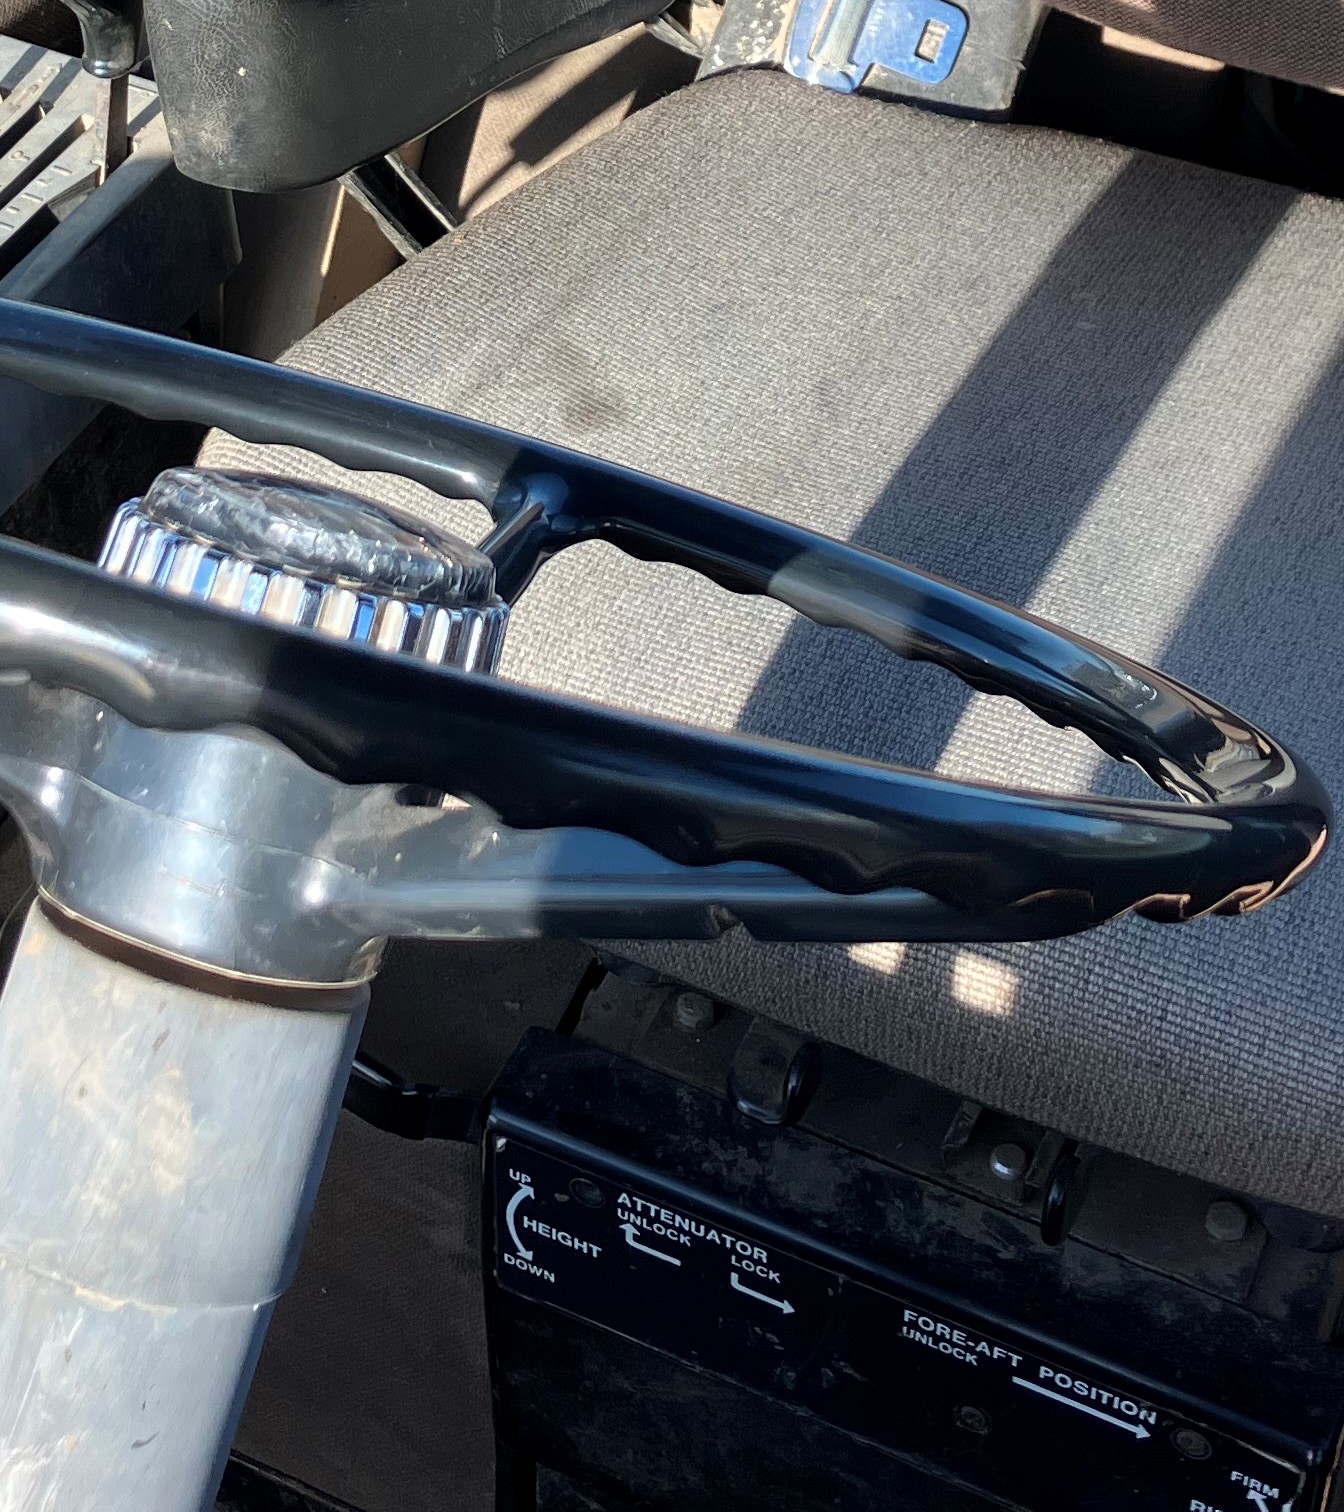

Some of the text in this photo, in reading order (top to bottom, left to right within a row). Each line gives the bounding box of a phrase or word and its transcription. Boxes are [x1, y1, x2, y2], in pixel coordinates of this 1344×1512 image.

[509, 1168, 531, 1185] UP
[523, 1216, 602, 1258] HEIGHT
[617, 1208, 691, 1246] UNLOCK
[617, 1192, 768, 1263] ATTENUATOR
[504, 1253, 555, 1283] DOWN
[731, 1255, 781, 1284] LOCK
[902, 1326, 978, 1366] UNLOCK
[904, 1309, 1157, 1424] FORE-AFT POSITION
[1230, 1471, 1279, 1499] FIRM
